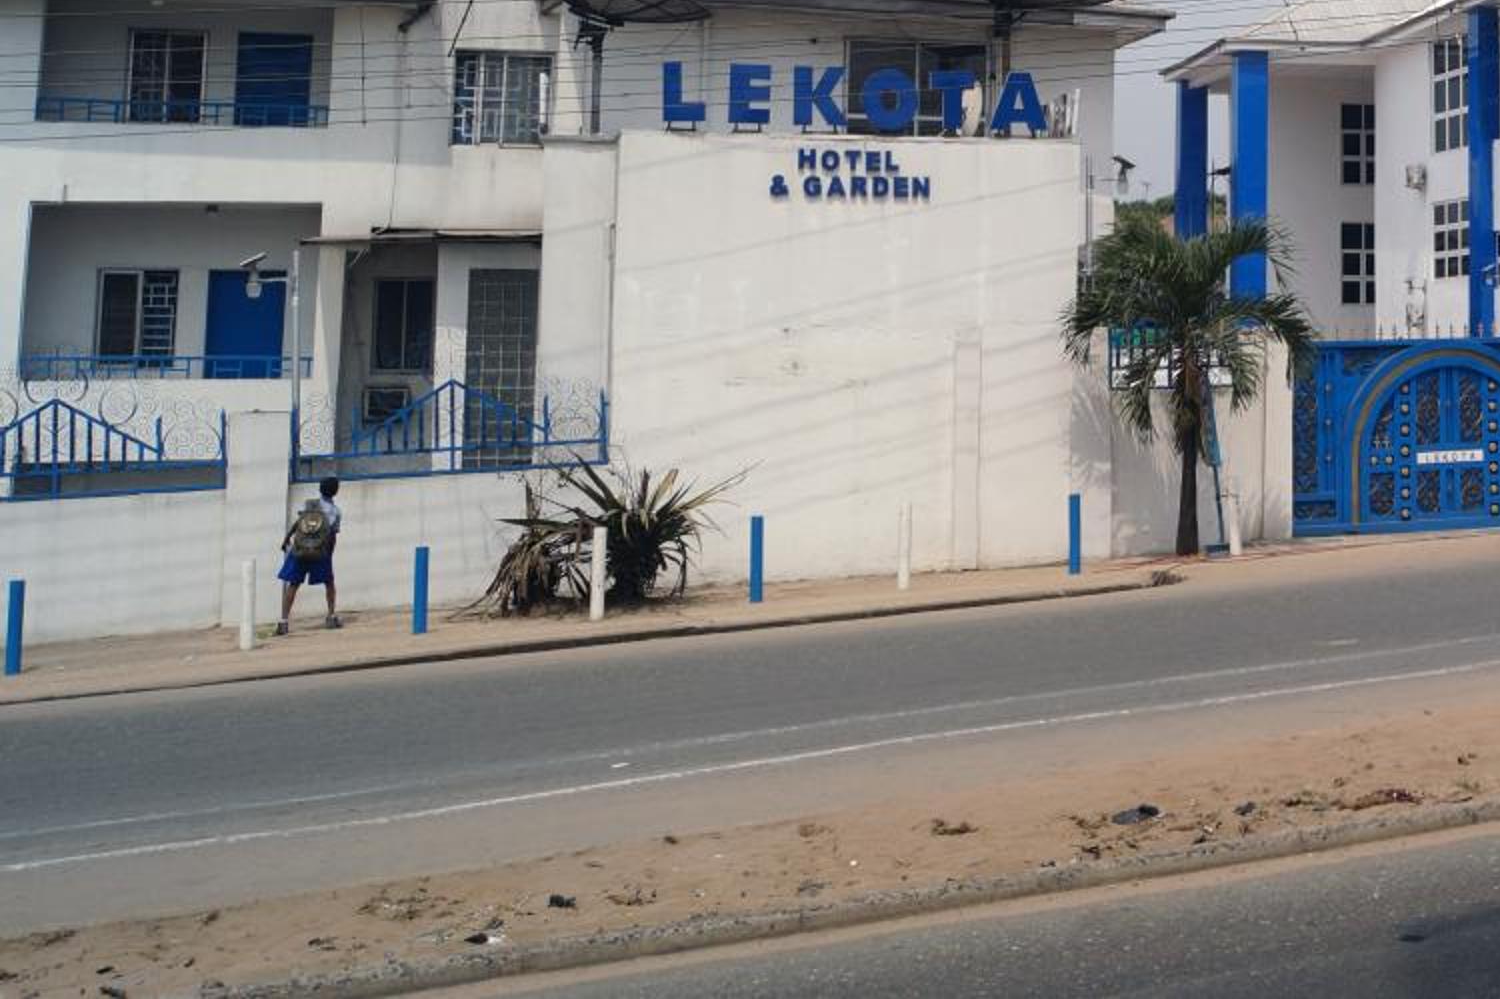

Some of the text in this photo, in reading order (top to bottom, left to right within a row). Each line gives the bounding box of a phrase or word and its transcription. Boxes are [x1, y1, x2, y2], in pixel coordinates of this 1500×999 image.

[661, 61, 1048, 137] LEKOTA
[797, 148, 900, 173] HOTEL
[770, 174, 931, 200] & GARDEN
